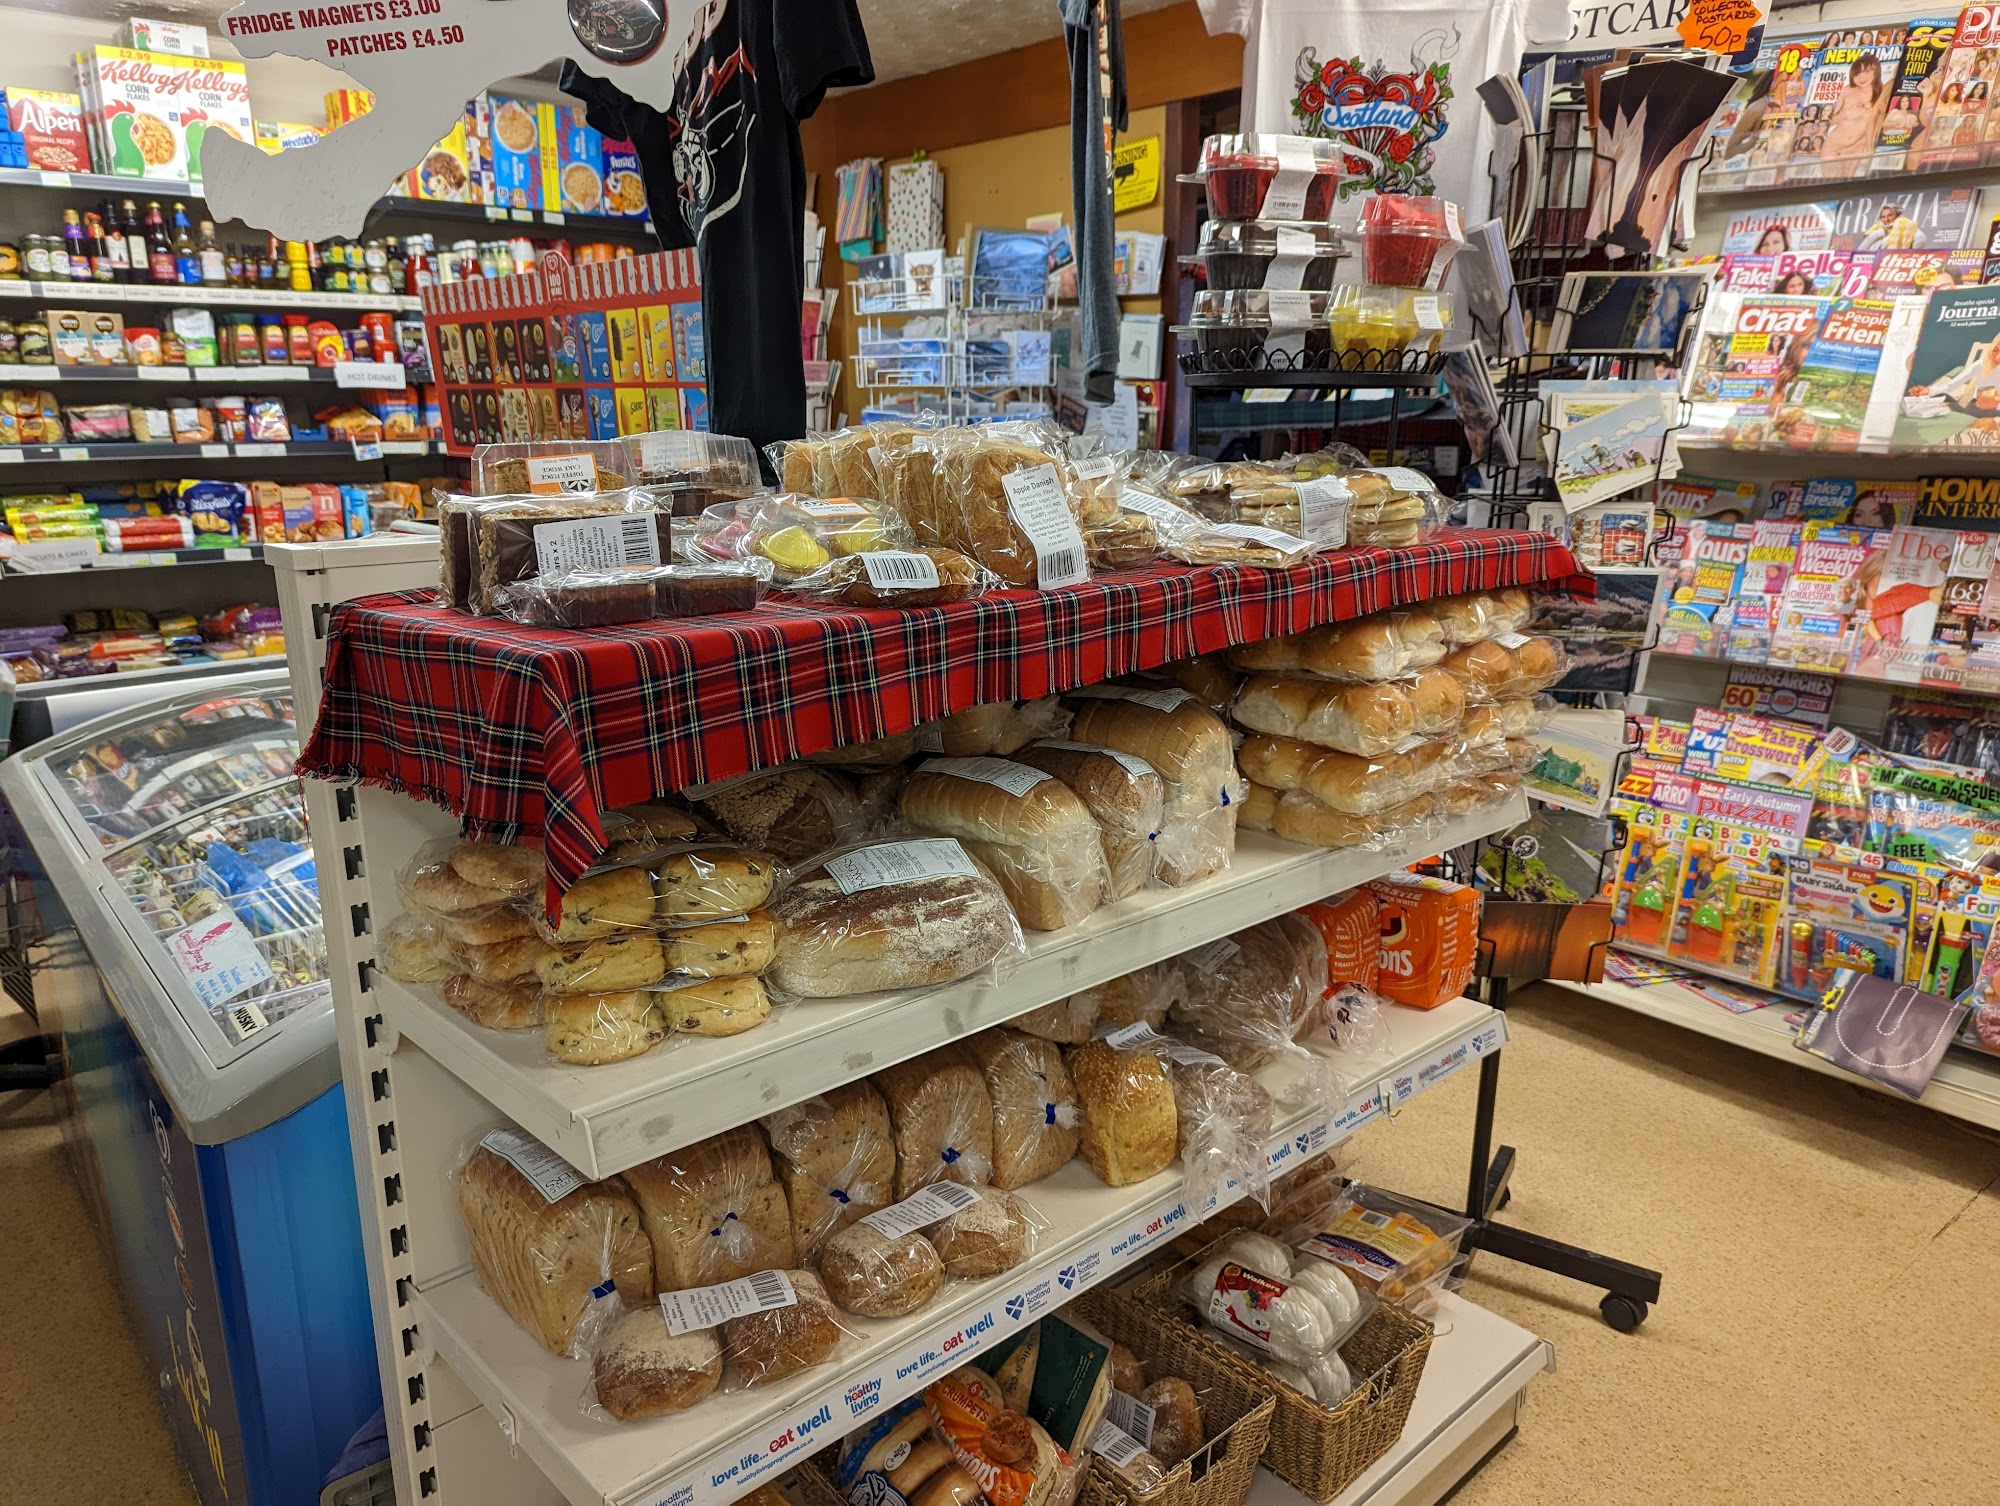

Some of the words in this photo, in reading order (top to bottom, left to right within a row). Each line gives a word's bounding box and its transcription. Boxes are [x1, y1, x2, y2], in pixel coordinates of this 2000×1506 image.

[1694, 1, 1754, 16] COLLECTION
[227, 12, 295, 36] FRIDGE
[298, 2, 387, 29] MAGNETS
[389, 0, 441, 18] £3.00
[1696, 10, 1756, 25] POSTCARDS
[163, 36, 180, 44] CORN
[327, 31, 407, 57] PATCHES
[412, 24, 465, 48] £4.50
[1699, 23, 1742, 52] 50p
[120, 50, 151, 61] £2.99
[1779, 50, 1800, 73] 18
[1824, 50, 1860, 63] NEW
[1907, 48, 1934, 63] KATY
[193, 59, 223, 70] £2.99
[1905, 62, 1927, 75] ANN
[1819, 72, 1847, 82] 100%
[125, 83, 149, 94] CORN
[1815, 83, 1842, 92] FRESH
[127, 93, 150, 102] FLAKES
[198, 92, 222, 102] CORN
[1324, 77, 1422, 129] Scotland
[1813, 91, 1842, 101] PUSSY
[200, 100, 222, 109] FLAKES
[20, 103, 81, 134] Alpen
[30, 135, 54, 145] ORIGINAL
[55, 136, 75, 146] RECIPE
[1880, 252, 1943, 269] that's
[1951, 250, 1986, 258] STUFFED
[1947, 258, 1976, 266] PUZZLES
[1730, 268, 1770, 286] Take
[1873, 267, 1916, 283] life!
[1976, 298, 1996, 306] special
[1738, 307, 1814, 333] Chat
[1937, 305, 2000, 323] Journa
[1815, 342, 1851, 353] Fabulous
[1853, 347, 1879, 355] fiction
[367, 374, 397, 383] DRINKS
[566, 464, 581, 472] CAKE
[1012, 482, 1031, 496] Apple
[1032, 477, 1055, 491] Danish
[1807, 481, 1838, 496] Take
[1843, 485, 1852, 495] a
[1919, 478, 2000, 504] HOM
[1053, 501, 1062, 509] egg
[1803, 493, 1848, 508] Break
[1754, 531, 1790, 547] Own
[1805, 528, 1818, 540] 20
[572, 529, 580, 555] chocolate
[1898, 533, 1949, 560] The
[1690, 537, 1747, 565] Yours
[1801, 543, 1866, 562] Woman's
[1697, 567, 1732, 579] HEALTH
[1799, 557, 1860, 577] Weekly
[1695, 578, 1728, 589] CHECKS
[1799, 582, 1811, 591] CUT
[1813, 584, 1833, 593] YOUR
[1789, 591, 1836, 601] CHOLESTEROL
[1950, 582, 1984, 601] 68
[1942, 627, 1968, 636] TREATS
[1729, 668, 1834, 696] WORDSEARCHES
[1725, 685, 1755, 707] 60
[1695, 709, 1717, 719] Take
[1733, 714, 1754, 726] Take
[1692, 718, 1722, 729] Break
[1731, 723, 1762, 736] Break
[1760, 728, 1791, 745] Take
[1797, 739, 1805, 748] a
[1688, 751, 1710, 760] WIN!
[1722, 755, 1745, 764] WITH
[1726, 737, 1800, 767] Crossword
[1699, 782, 1717, 792] Take
[1902, 773, 1937, 793] MEGA
[1724, 788, 1753, 807] Early
[1756, 795, 1801, 812] Autumn
[1695, 799, 1798, 829] PUZZLE
[1703, 813, 1795, 835] COLLECTION
[1721, 827, 1763, 847] Busy
[1716, 841, 1766, 860] Time!
[1894, 843, 1926, 858] FREE
[1790, 859, 1809, 869] 40
[1863, 854, 1881, 866] 46
[1886, 861, 1919, 875] COOL
[1796, 875, 1820, 887] BABY
[1822, 879, 1859, 895] SHARK
[1395, 898, 1418, 908] WHITE
[233, 1006, 257, 1032] HUSKY
[1441, 1054, 1453, 1066] eat
[1452, 1044, 1467, 1061] well
[1394, 1075, 1413, 1090] healthy
[1397, 1085, 1412, 1097] living
[1334, 1116, 1347, 1129] love
[1360, 1099, 1373, 1114] eat
[1309, 1123, 1327, 1137] Healthier
[1310, 1128, 1327, 1142] Scotland
[1271, 1143, 1291, 1164] well
[1110, 1239, 1128, 1256] love
[1128, 1232, 1147, 1246] life...
[1146, 1217, 1163, 1235] eat
[1163, 1202, 1186, 1226] well
[1075, 1251, 1100, 1269] Healthier
[1077, 1258, 1101, 1275] Scotland
[1025, 1279, 1051, 1298] Healthier
[1026, 1287, 1051, 1305] Scotland
[896, 1359, 919, 1380] love
[919, 1348, 943, 1367] life...
[942, 1330, 965, 1352] eat
[964, 1311, 995, 1340] well
[844, 1378, 882, 1406] healthy
[970, 1384, 979, 1393] 6
[850, 1392, 880, 1414] living
[941, 1383, 989, 1422] CRUMPETS
[711, 1463, 739, 1488] love
[740, 1451, 769, 1471] life...
[769, 1428, 795, 1453] eat
[796, 1404, 832, 1437] well
[736, 1437, 815, 1486] healthylivingprogramme.co.uk
